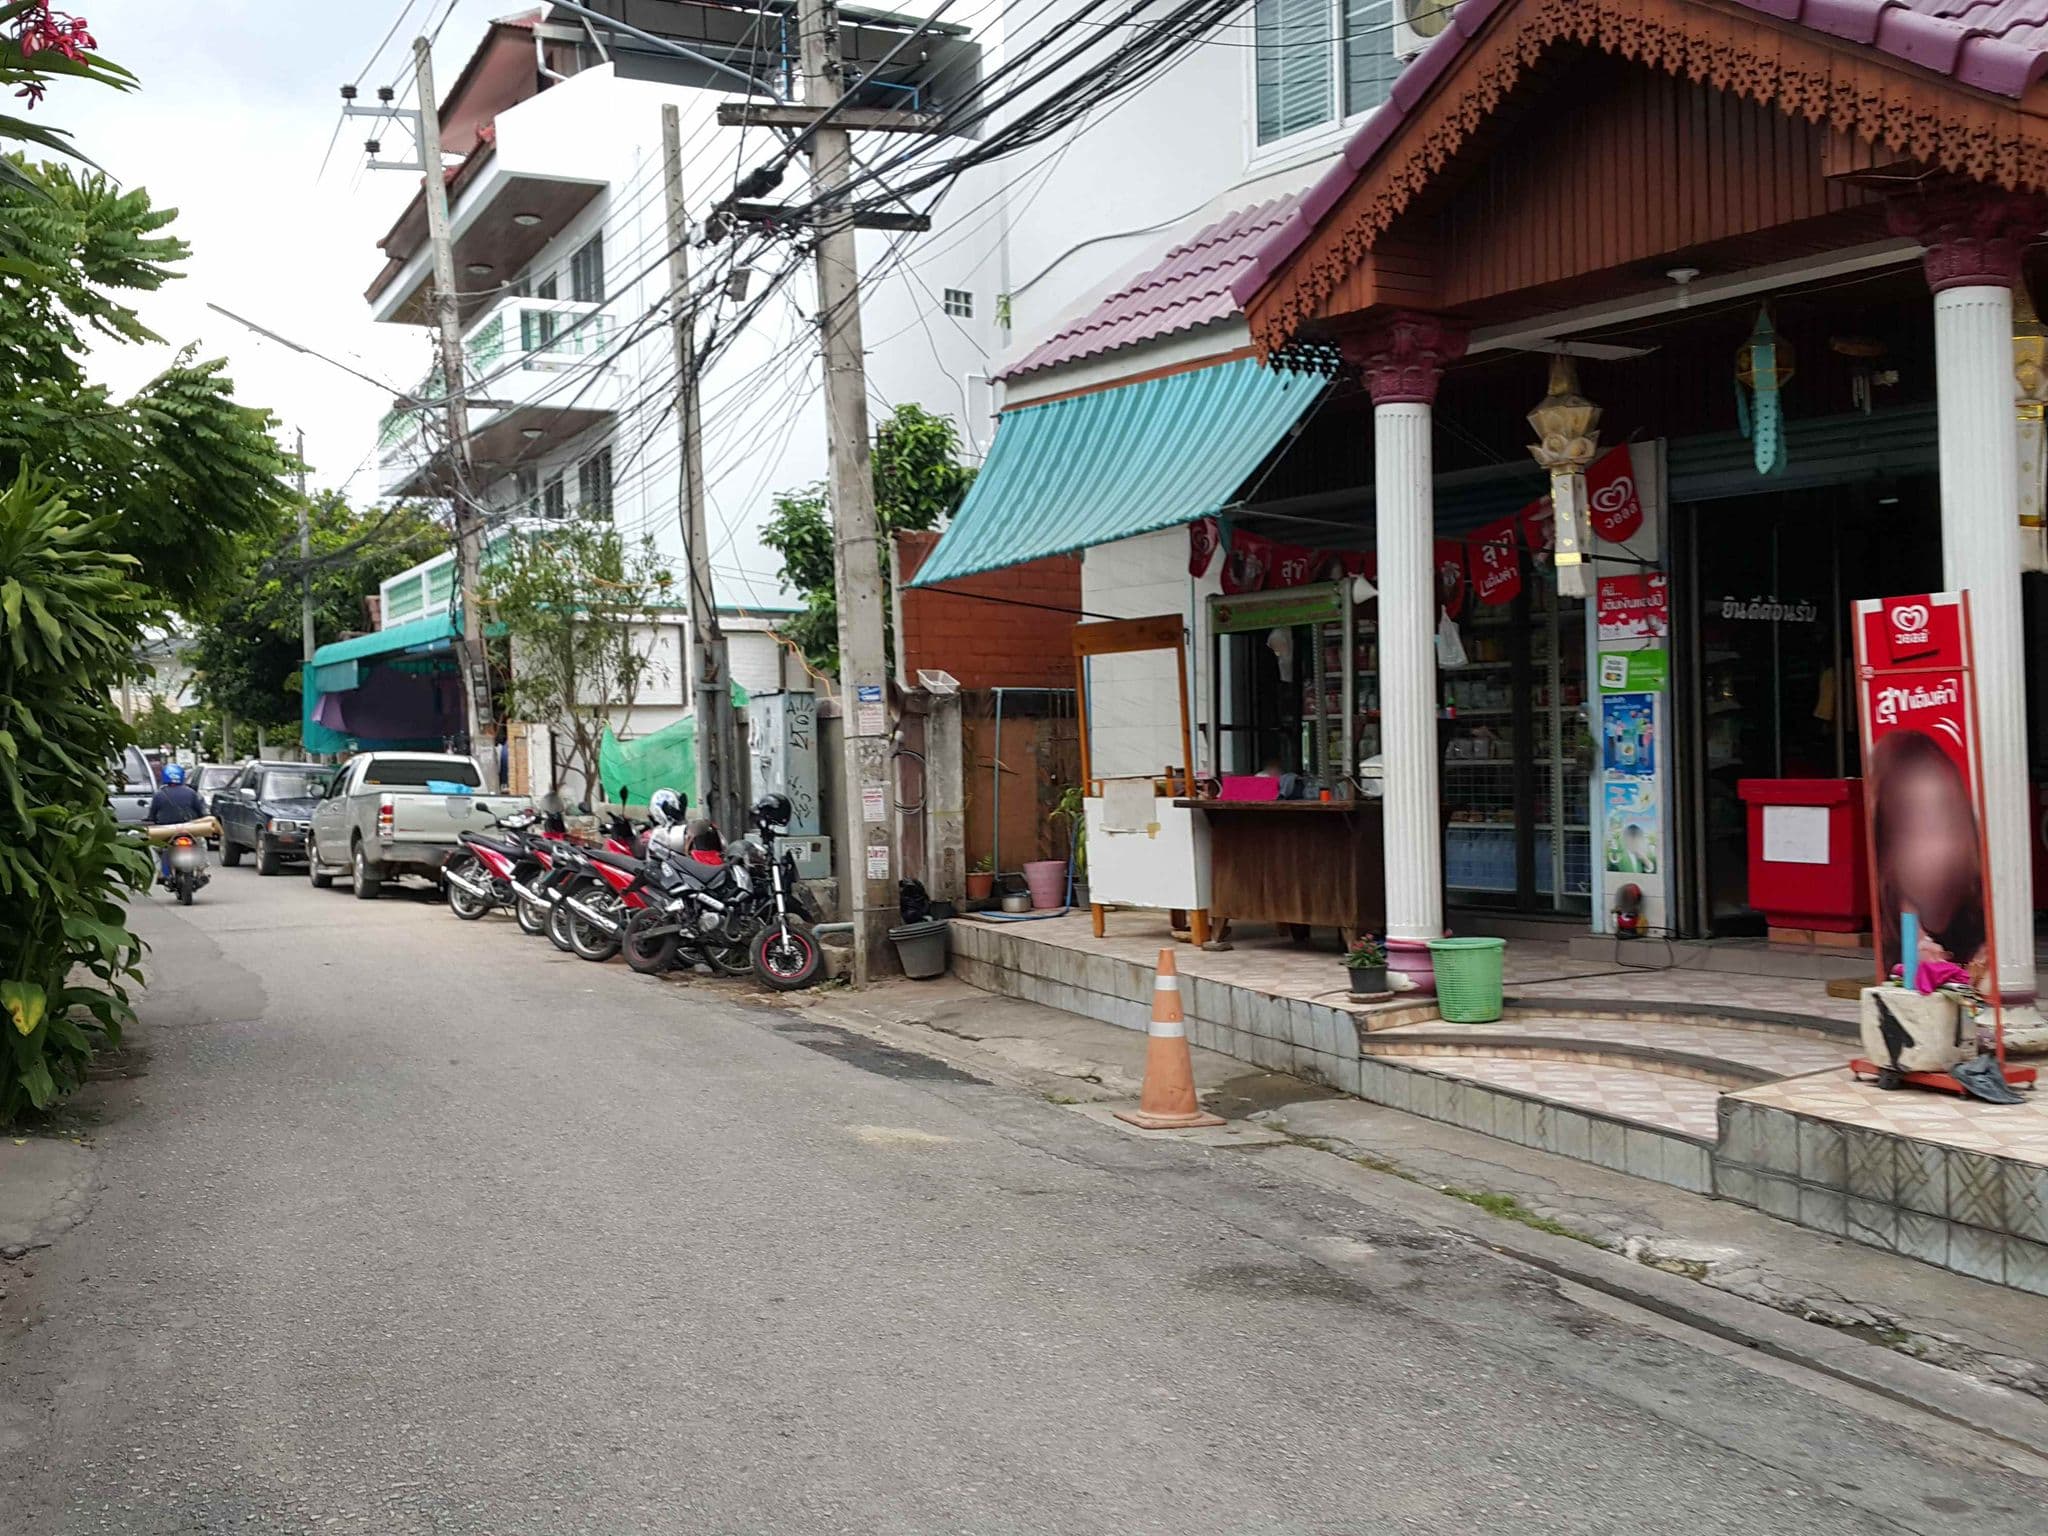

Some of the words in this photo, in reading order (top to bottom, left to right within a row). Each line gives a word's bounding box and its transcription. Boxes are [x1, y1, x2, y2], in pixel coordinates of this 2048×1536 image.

[1721, 595, 1817, 622] ยินดีต้อนรับ
